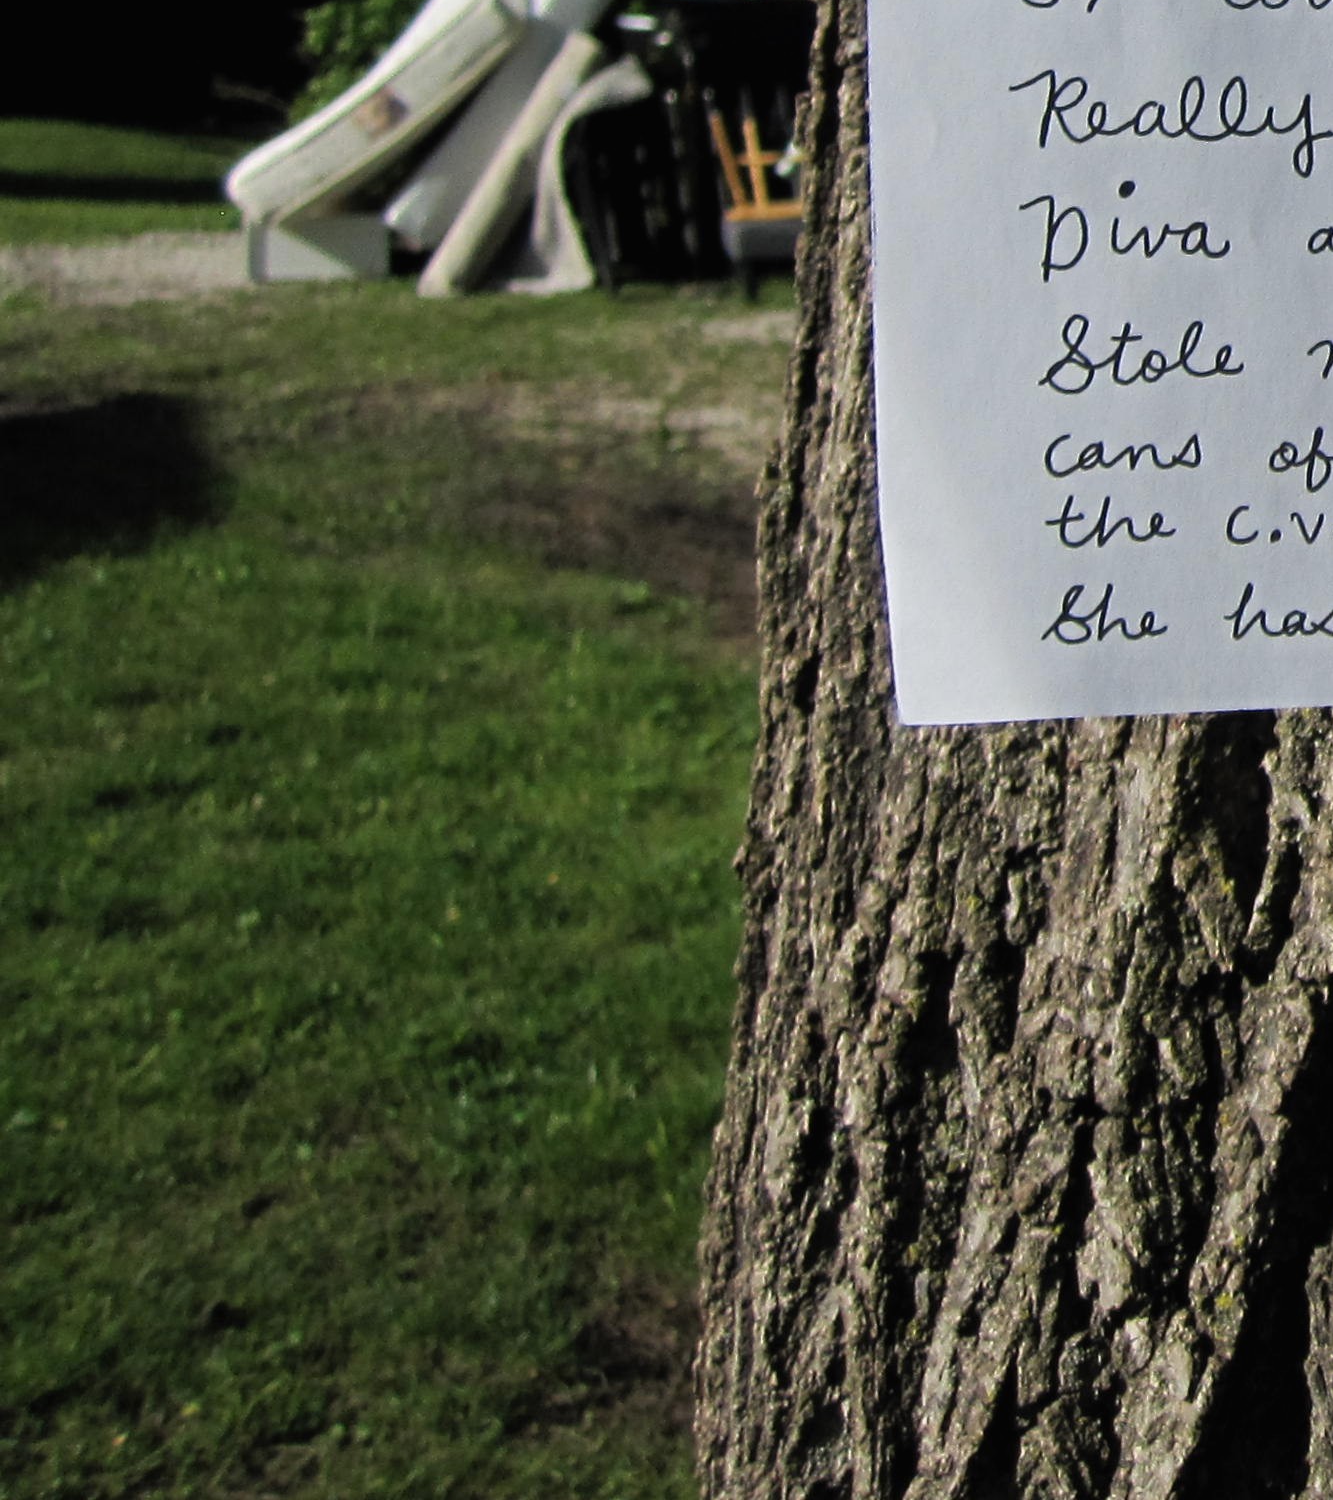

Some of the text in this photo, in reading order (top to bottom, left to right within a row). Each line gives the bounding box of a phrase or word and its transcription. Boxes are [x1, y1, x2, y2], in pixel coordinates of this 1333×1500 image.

[1018, 180, 1231, 284] Diva
[1037, 313, 1245, 396] Stole
[1044, 433, 1202, 479] cans
[1044, 494, 1177, 549] the
[1040, 582, 1169, 645] She
